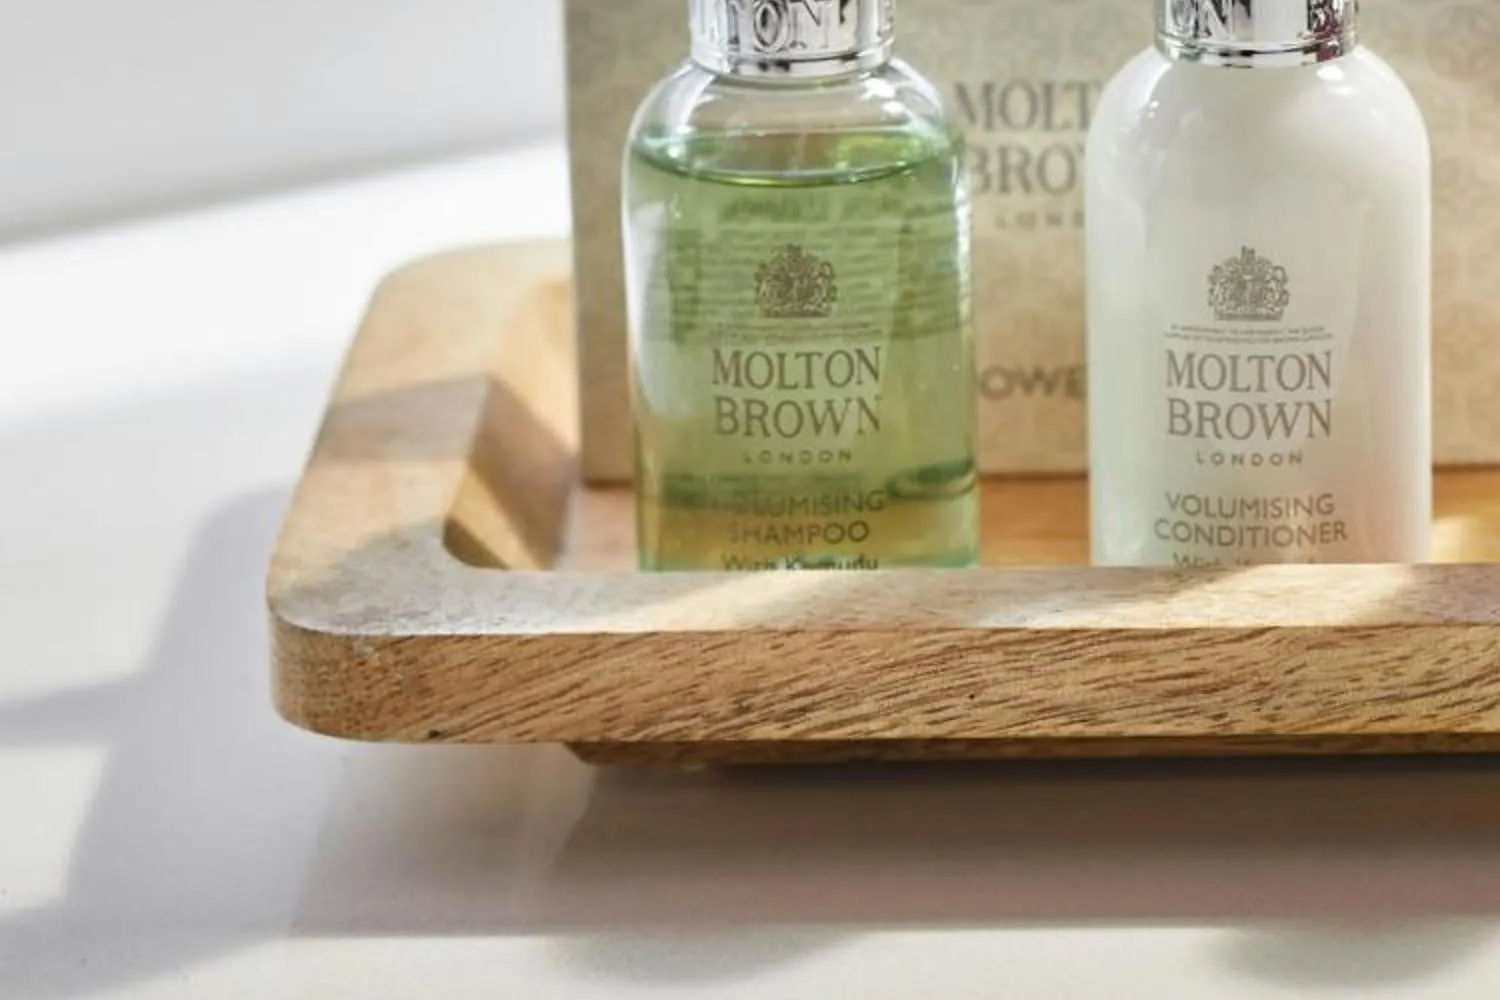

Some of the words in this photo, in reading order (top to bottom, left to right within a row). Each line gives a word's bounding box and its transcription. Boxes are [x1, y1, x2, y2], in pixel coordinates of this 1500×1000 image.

[954, 79, 1103, 132] MOLT
[971, 143, 1086, 196] BRO
[712, 346, 882, 390] MOLTON
[1166, 350, 1332, 393] MOLTON
[714, 395, 882, 439] BROWN
[1166, 397, 1332, 440] BROWN
[743, 449, 852, 465] LONDON
[1195, 450, 1303, 467] LONDON
[1164, 492, 1335, 519] VOLUMISING
[727, 519, 871, 545] SHAMPOO
[1153, 517, 1349, 549] CONDITIONER
